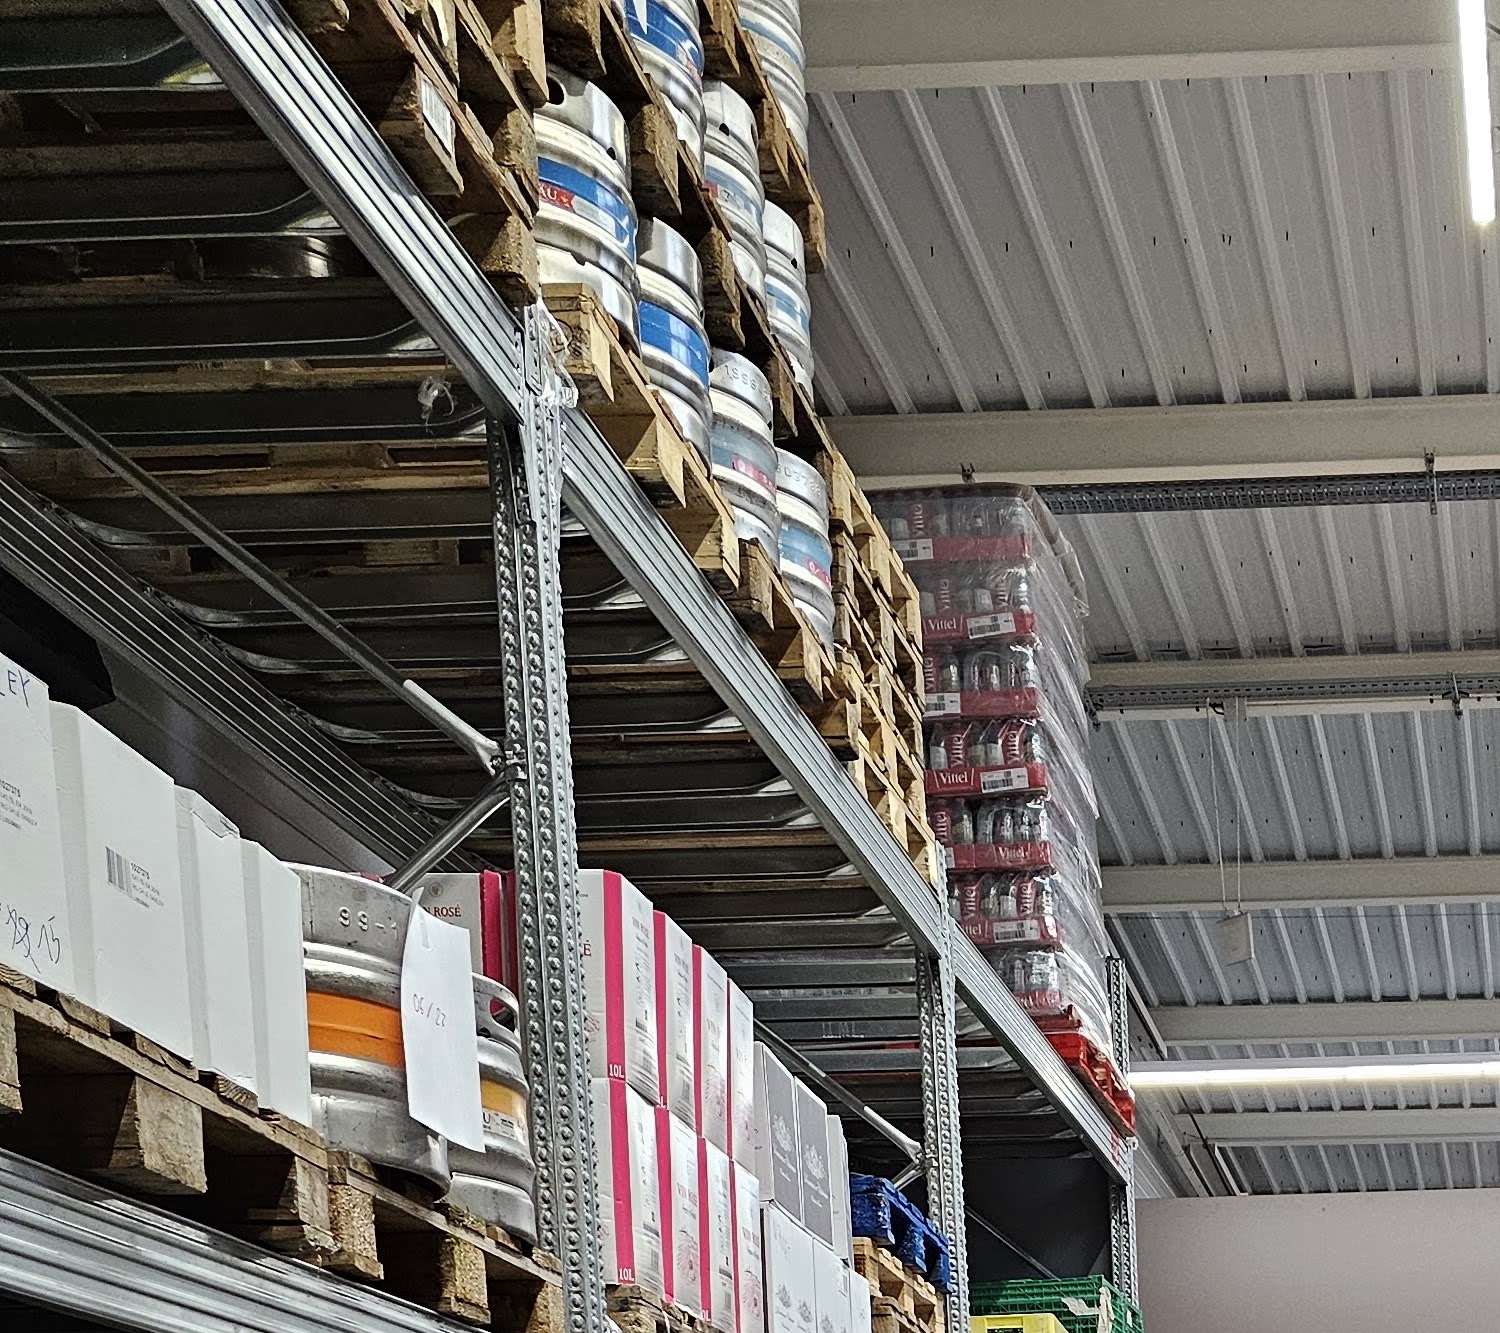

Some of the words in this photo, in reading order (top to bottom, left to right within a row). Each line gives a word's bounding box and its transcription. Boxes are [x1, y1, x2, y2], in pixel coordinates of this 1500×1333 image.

[928, 617, 957, 632] Vittel
[0, 668, 30, 708] EY
[939, 770, 969, 786] Vittel
[434, 903, 462, 918] ROSÉ
[609, 1064, 626, 1079] 10L
[619, 1267, 635, 1281] 10L
